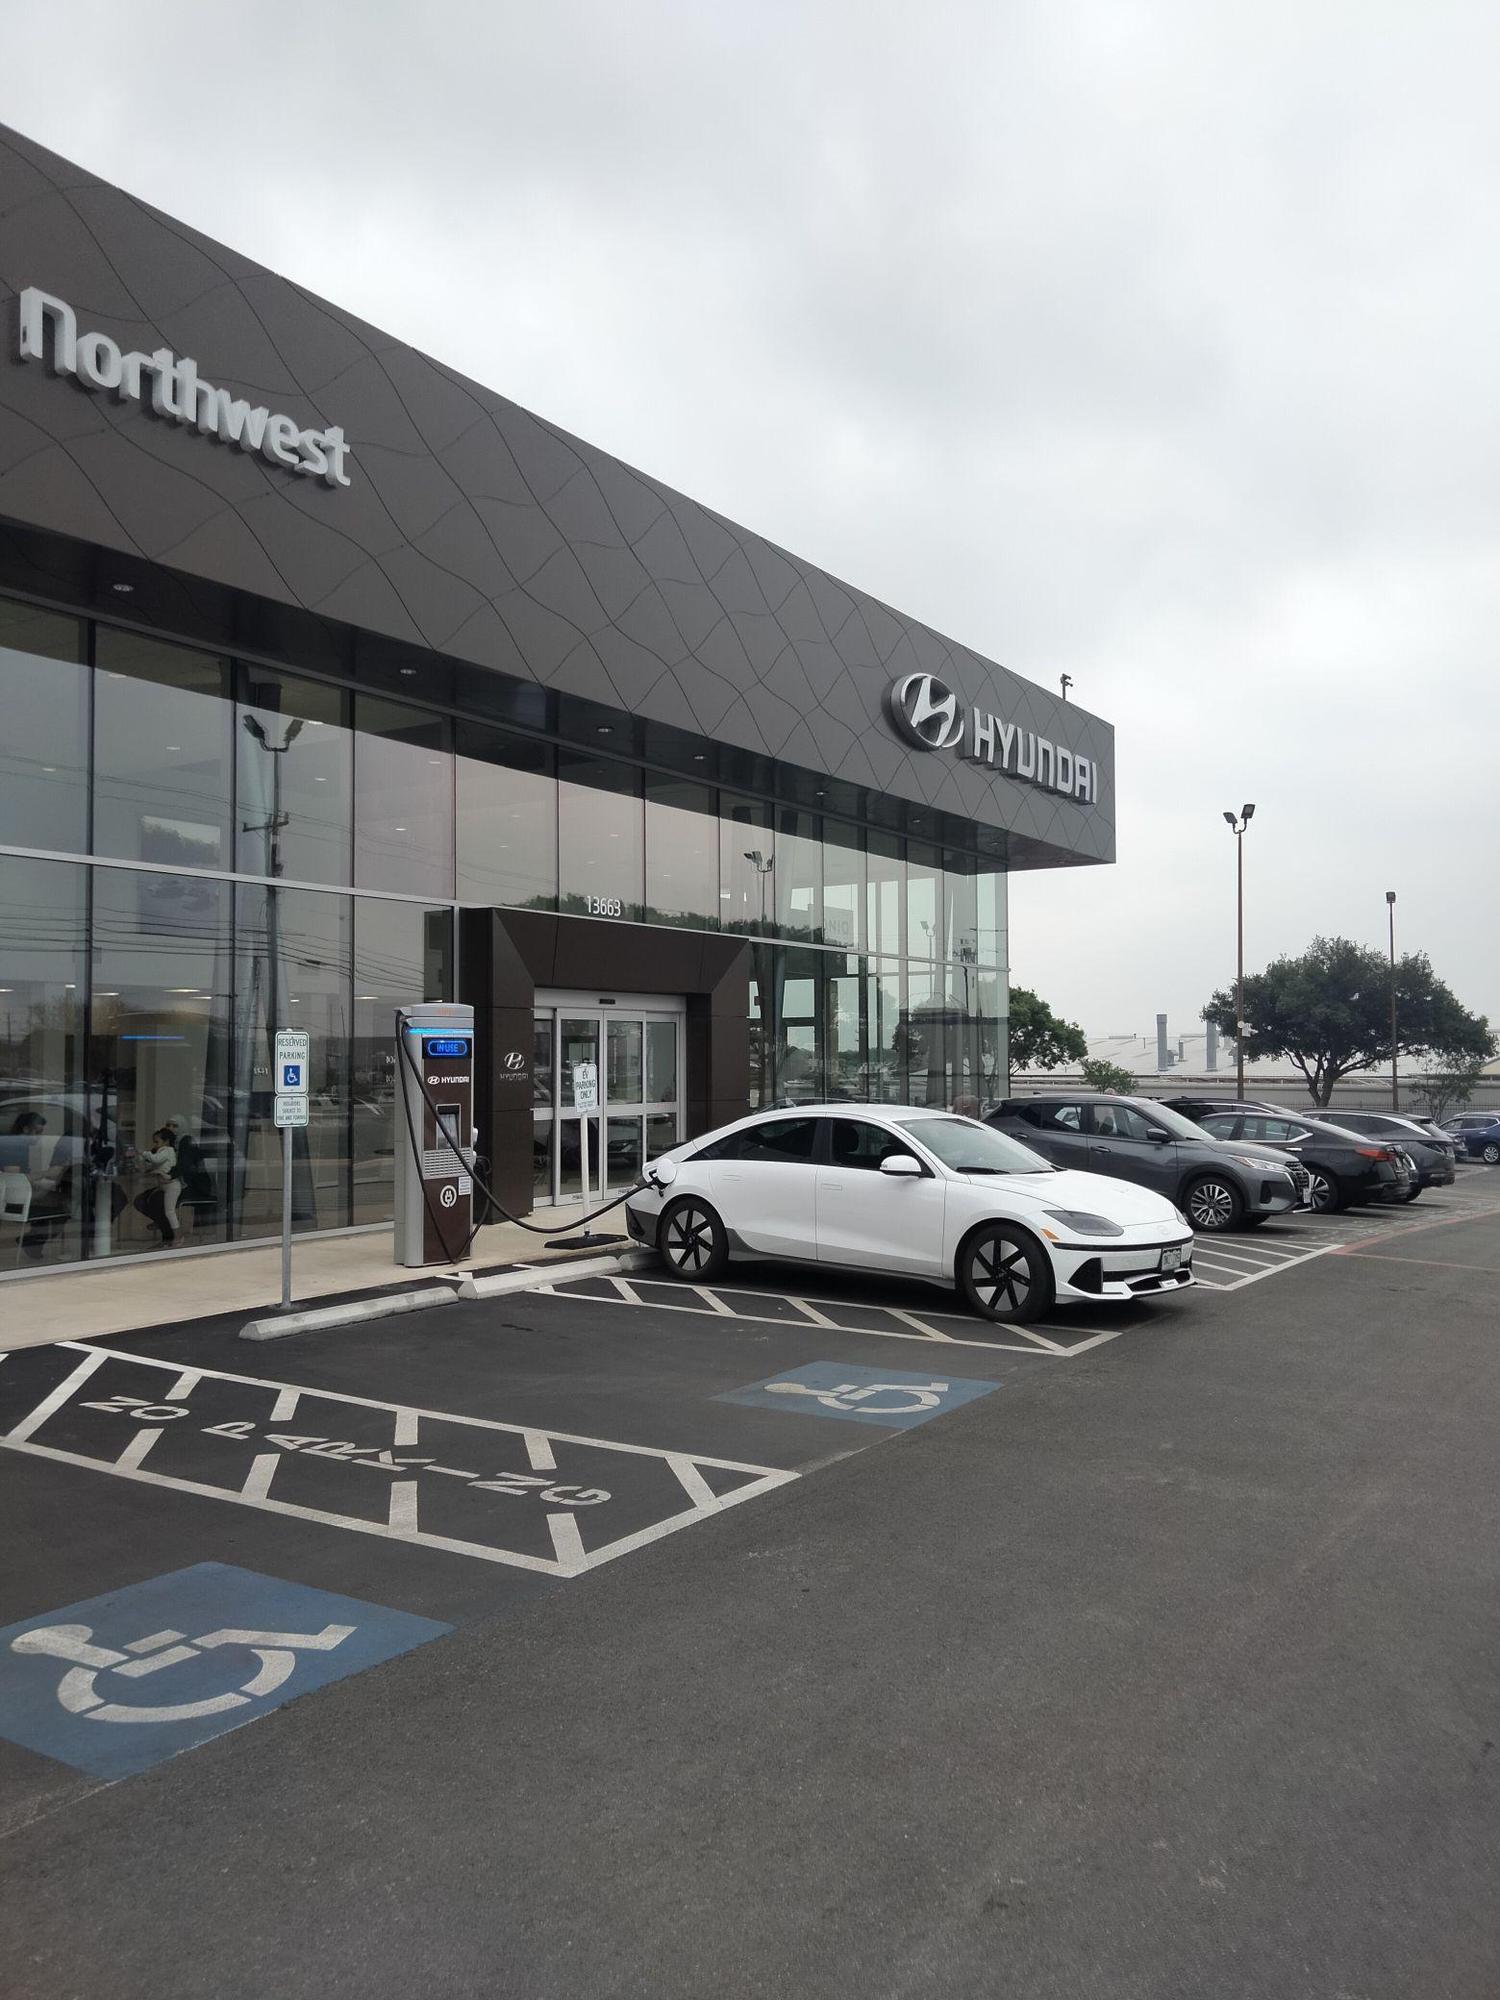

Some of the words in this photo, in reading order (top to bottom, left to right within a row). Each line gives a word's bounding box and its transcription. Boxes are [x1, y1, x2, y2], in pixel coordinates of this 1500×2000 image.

[970, 706, 1097, 805] HYUNDAI
[586, 895, 621, 917] 13663
[278, 1038, 307, 1047] RESERVED
[436, 1043, 444, 1053] IN
[444, 1043, 459, 1053] USE
[279, 1051, 306, 1060] PARKING
[441, 1075, 470, 1084] HYUNDAI
[575, 1079, 596, 1090] PARKING
[79, 1396, 190, 1421] NO
[200, 1421, 612, 1506] PARKING
